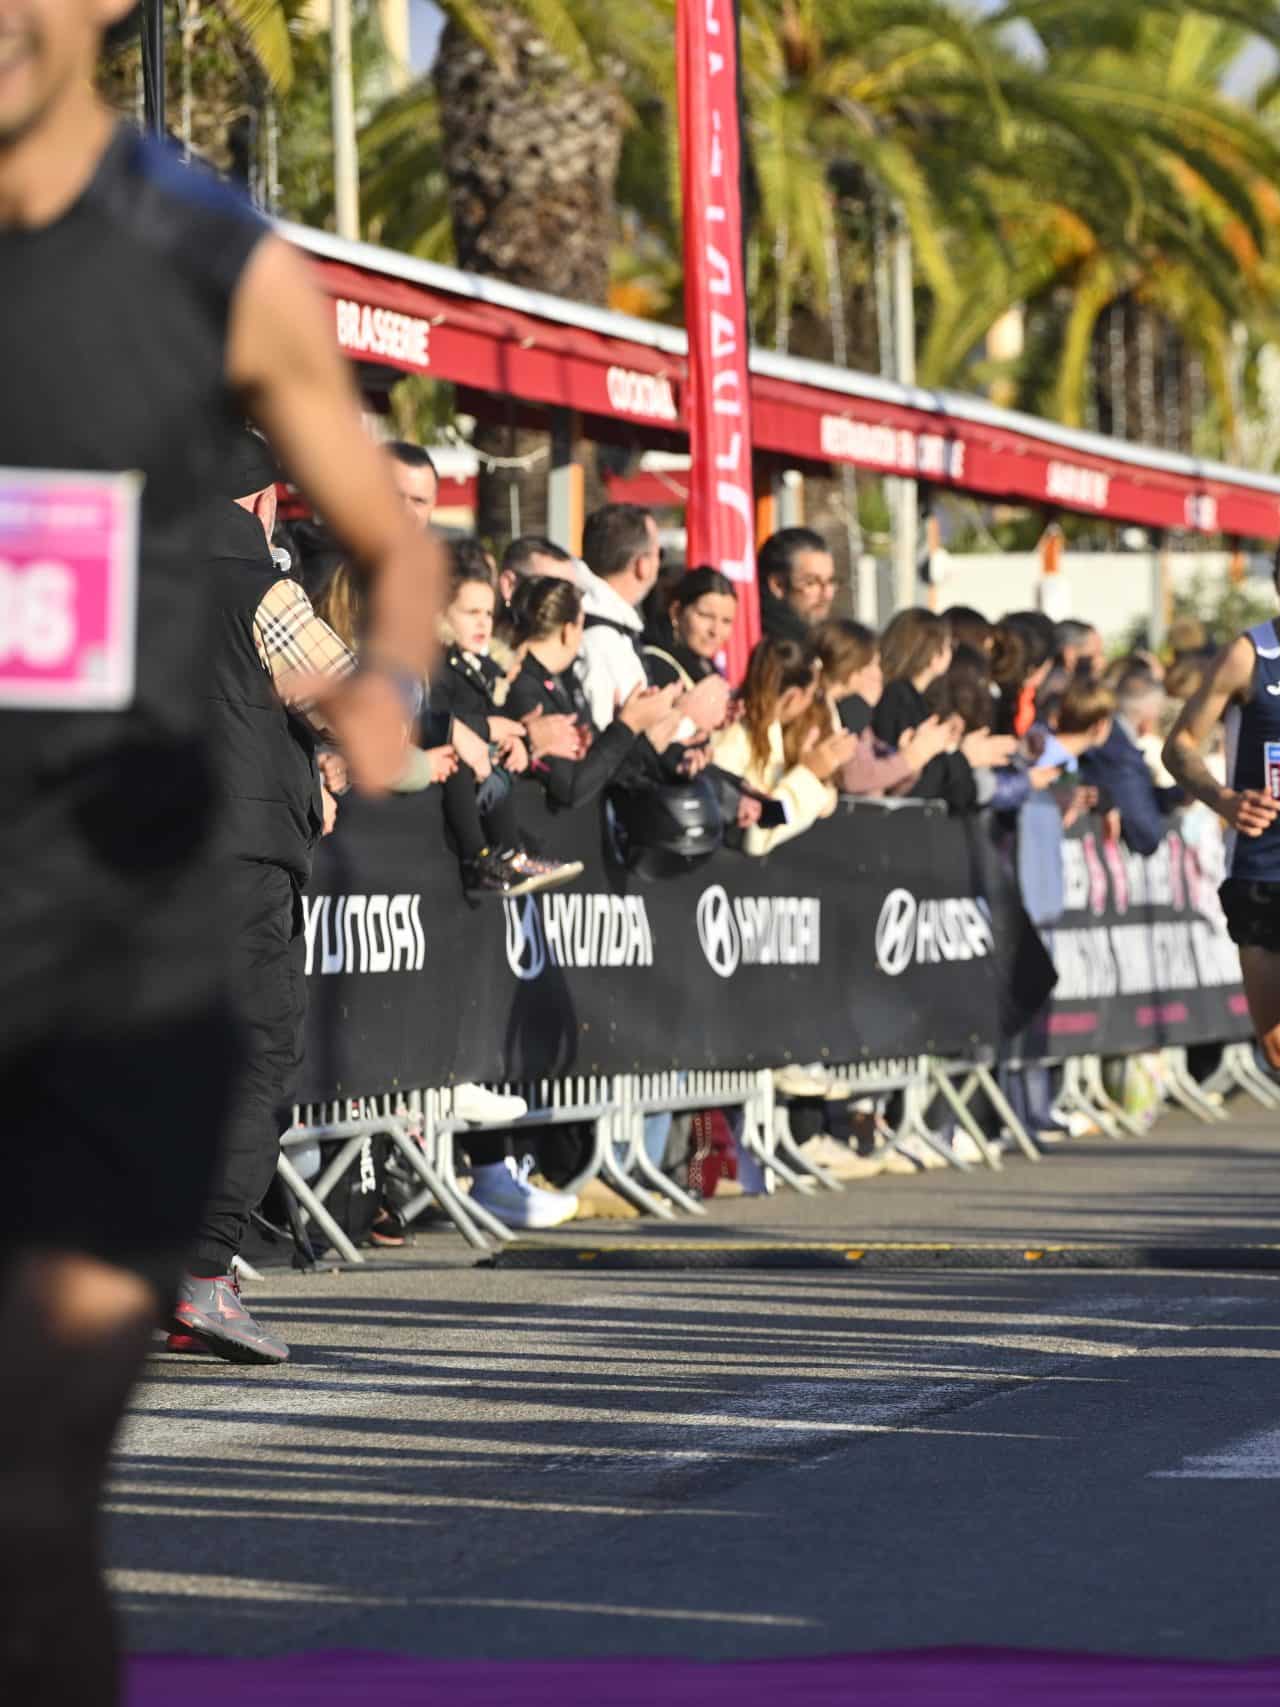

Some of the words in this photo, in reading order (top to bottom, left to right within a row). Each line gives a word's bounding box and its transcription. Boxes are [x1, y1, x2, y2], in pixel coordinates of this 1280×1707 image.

[336, 299, 430, 366] BRASSERIE
[301, 894, 426, 976] YUNDAI
[543, 893, 654, 967] HYUNDAI
